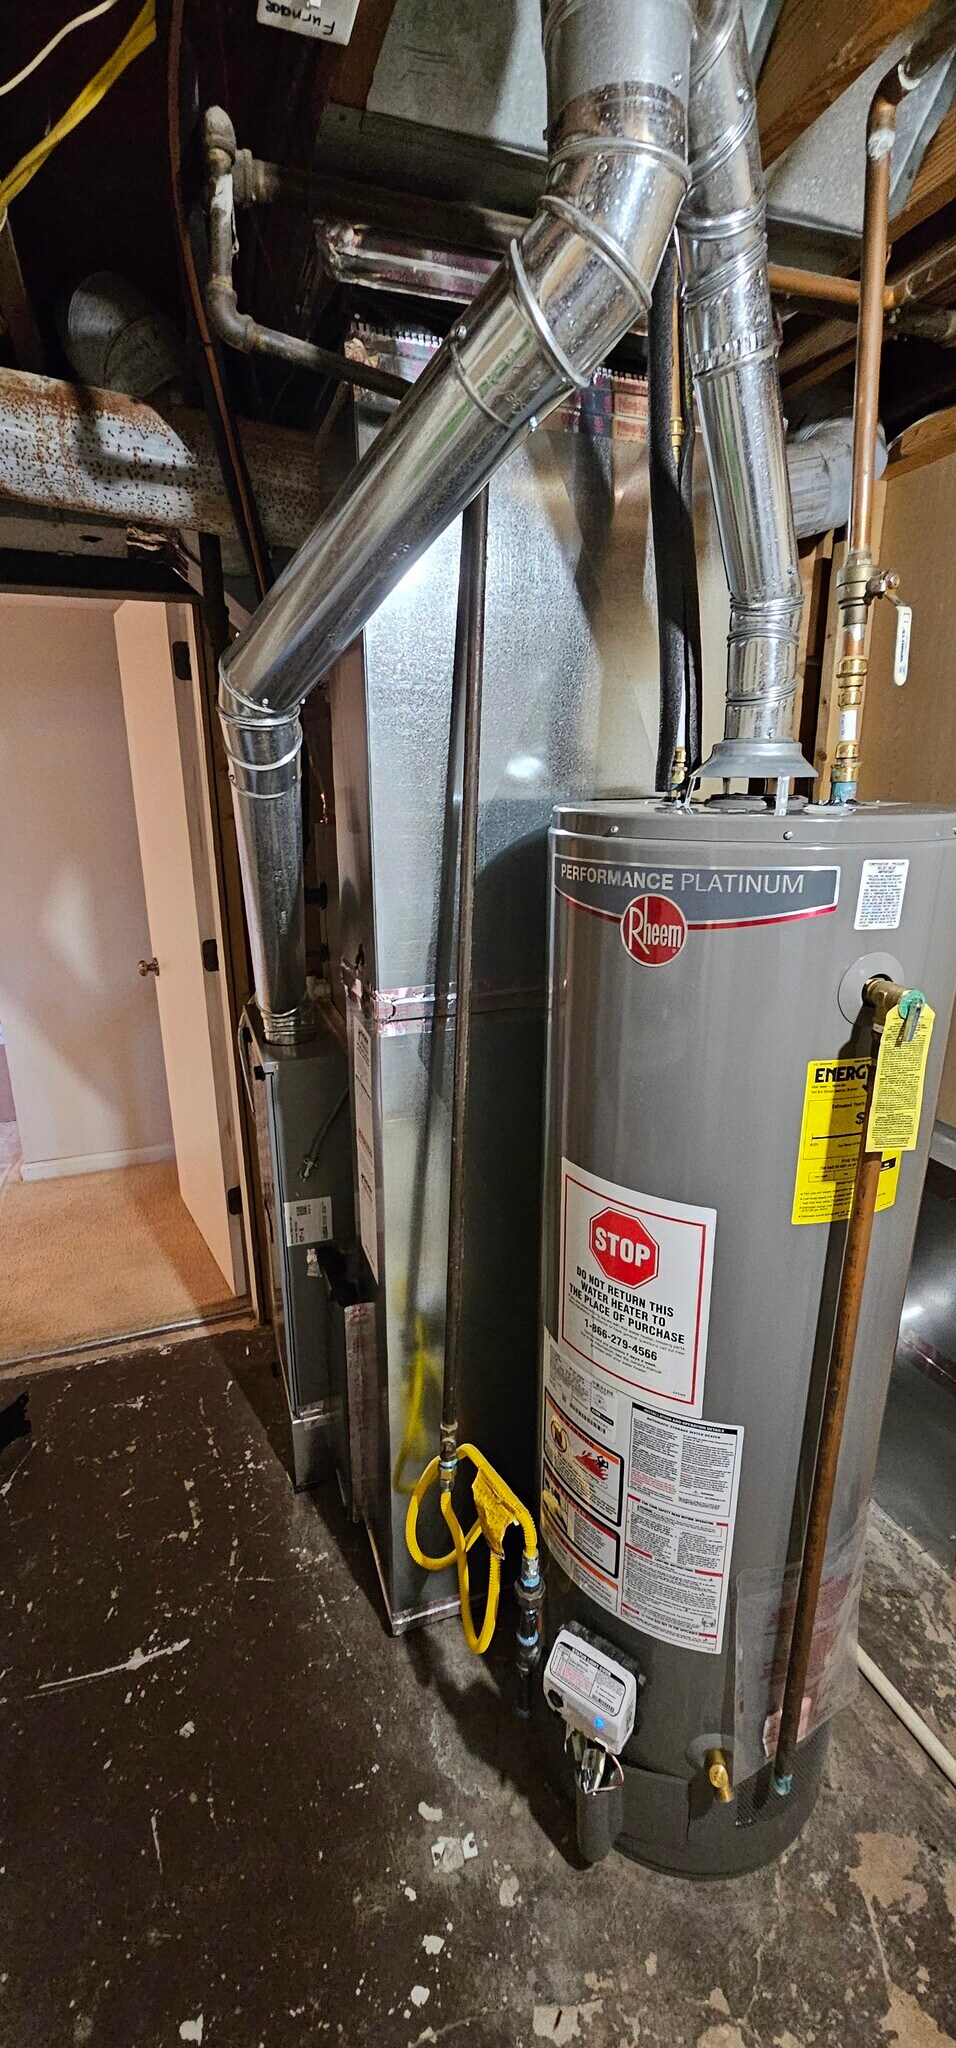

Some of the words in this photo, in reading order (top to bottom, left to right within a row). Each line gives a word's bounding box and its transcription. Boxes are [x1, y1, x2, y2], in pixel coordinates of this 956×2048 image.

[561, 864, 673, 890] PERFORMANCE
[681, 873, 804, 894] PLATINUM
[628, 898, 681, 955] Rheem
[595, 1227, 651, 1267] STOP
[569, 1283, 582, 1301] THE
[584, 1294, 610, 1317] PLACE
[613, 1311, 625, 1324] OF
[628, 1319, 685, 1344] PURCHASE
[577, 1266, 586, 1280] DO
[589, 1274, 605, 1290] NOT
[608, 1285, 646, 1308] RETURN
[649, 1301, 674, 1317] THIS
[581, 1281, 608, 1304] WATER
[611, 1298, 648, 1321] HEATER
[652, 1314, 666, 1326] TO
[584, 1318, 657, 1360] 1-866-279-4566
